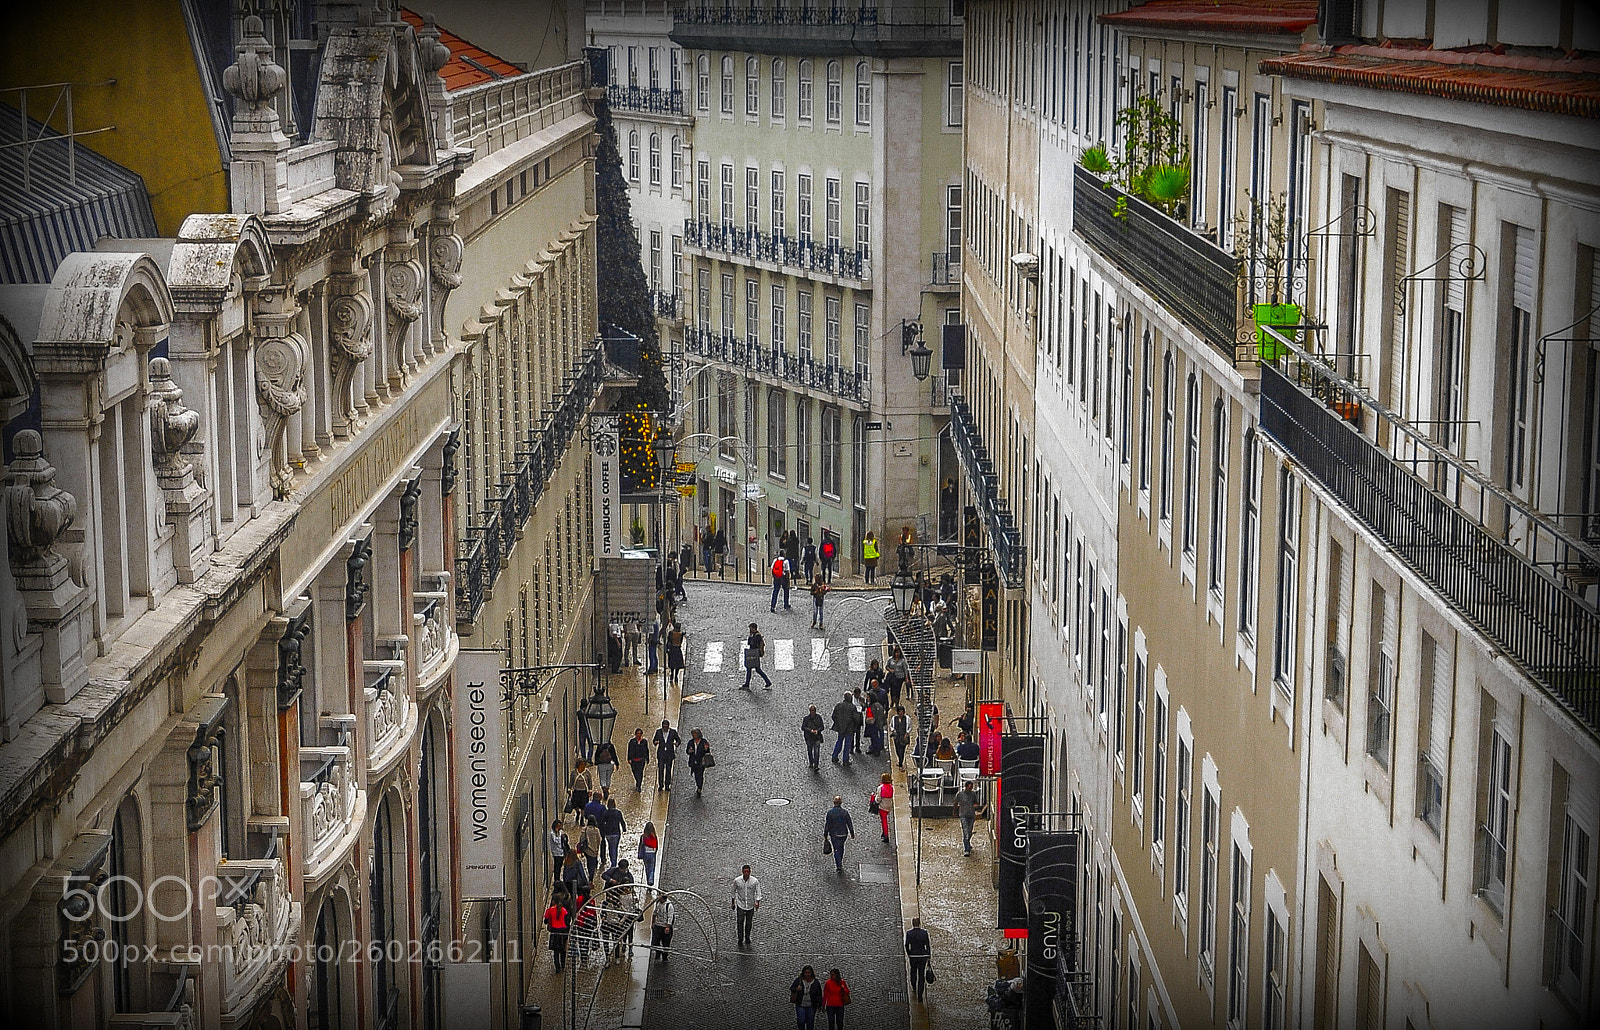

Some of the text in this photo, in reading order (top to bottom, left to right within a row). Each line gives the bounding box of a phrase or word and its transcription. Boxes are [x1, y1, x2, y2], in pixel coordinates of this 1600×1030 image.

[603, 498, 611, 554] STARBUCKS
[467, 681, 489, 842] women'secret
[1013, 804, 1030, 849] envy
[1043, 911, 1061, 960] envy
